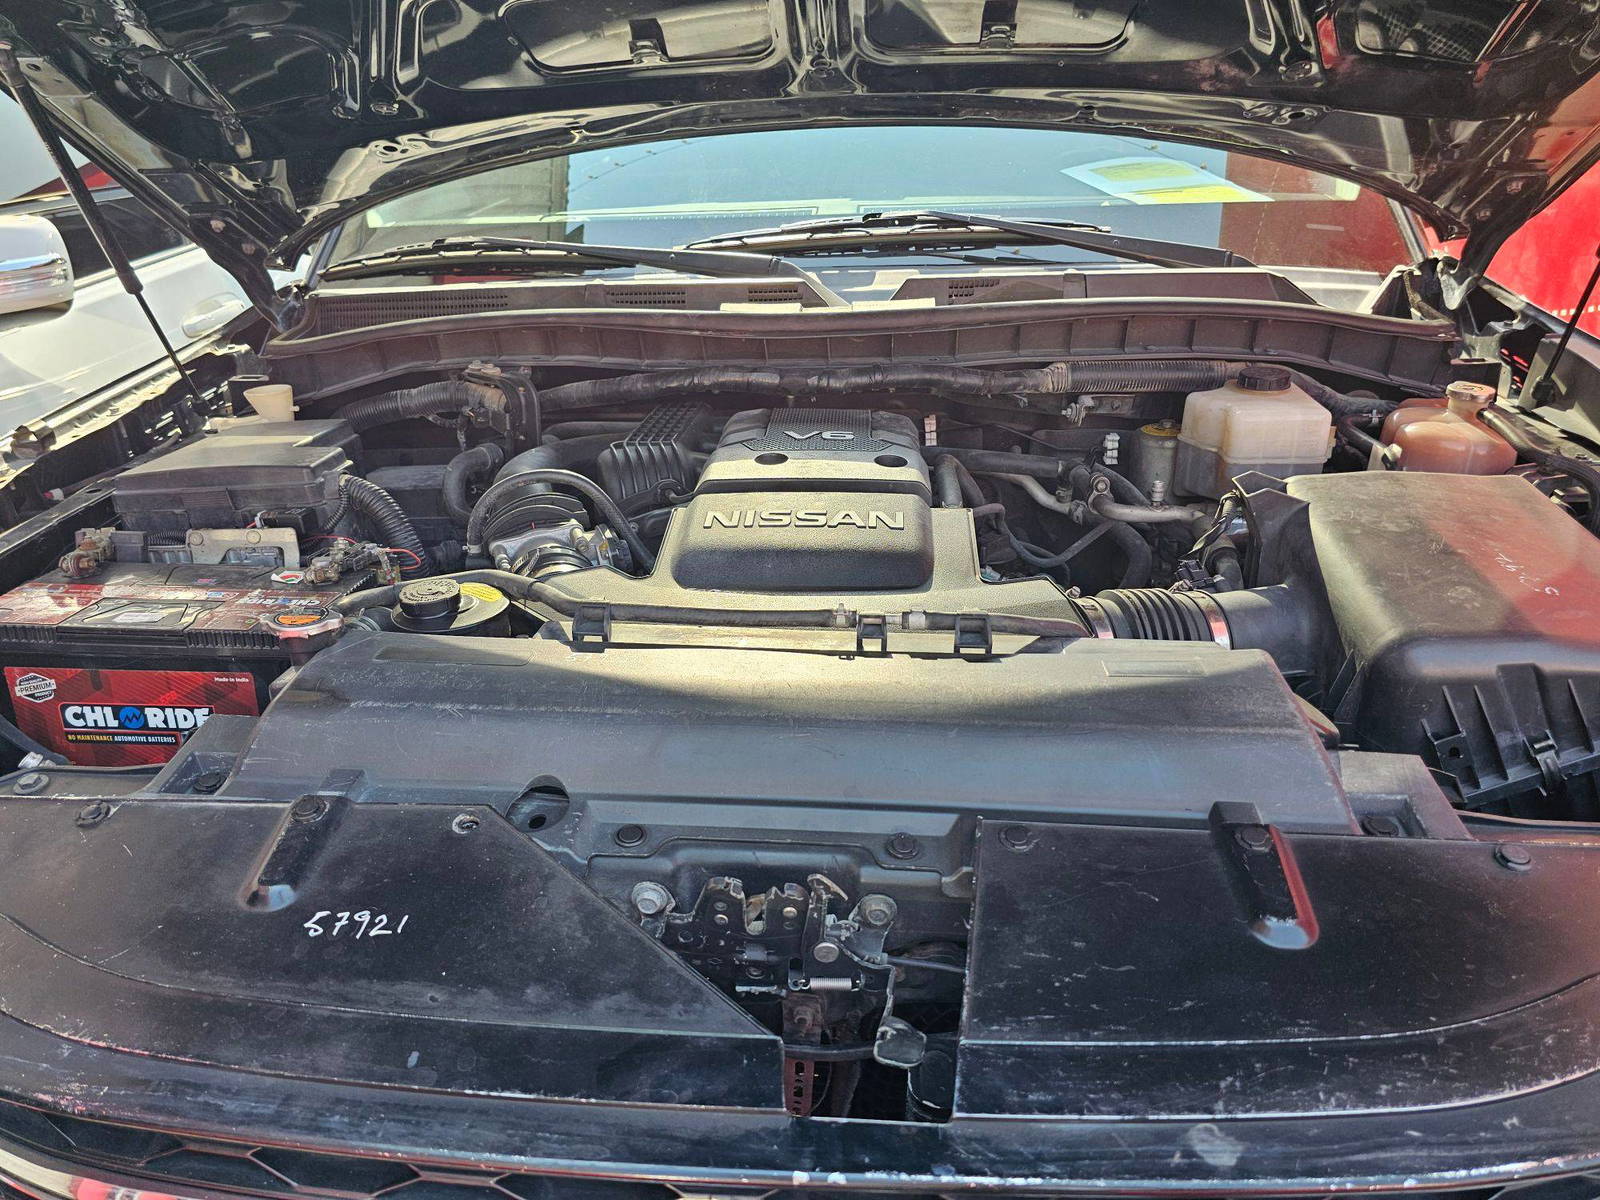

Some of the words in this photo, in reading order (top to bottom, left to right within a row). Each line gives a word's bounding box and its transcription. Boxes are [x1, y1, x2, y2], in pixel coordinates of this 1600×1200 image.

[783, 430, 855, 441] V6
[703, 509, 905, 530] NISSAN
[20, 682, 53, 694] PREMIUM
[77, 734, 113, 742] MAINTENANCE
[114, 735, 147, 743] AUTOMOTIVE
[148, 736, 176, 744] BATTERIES
[303, 910, 409, 940] 57921
